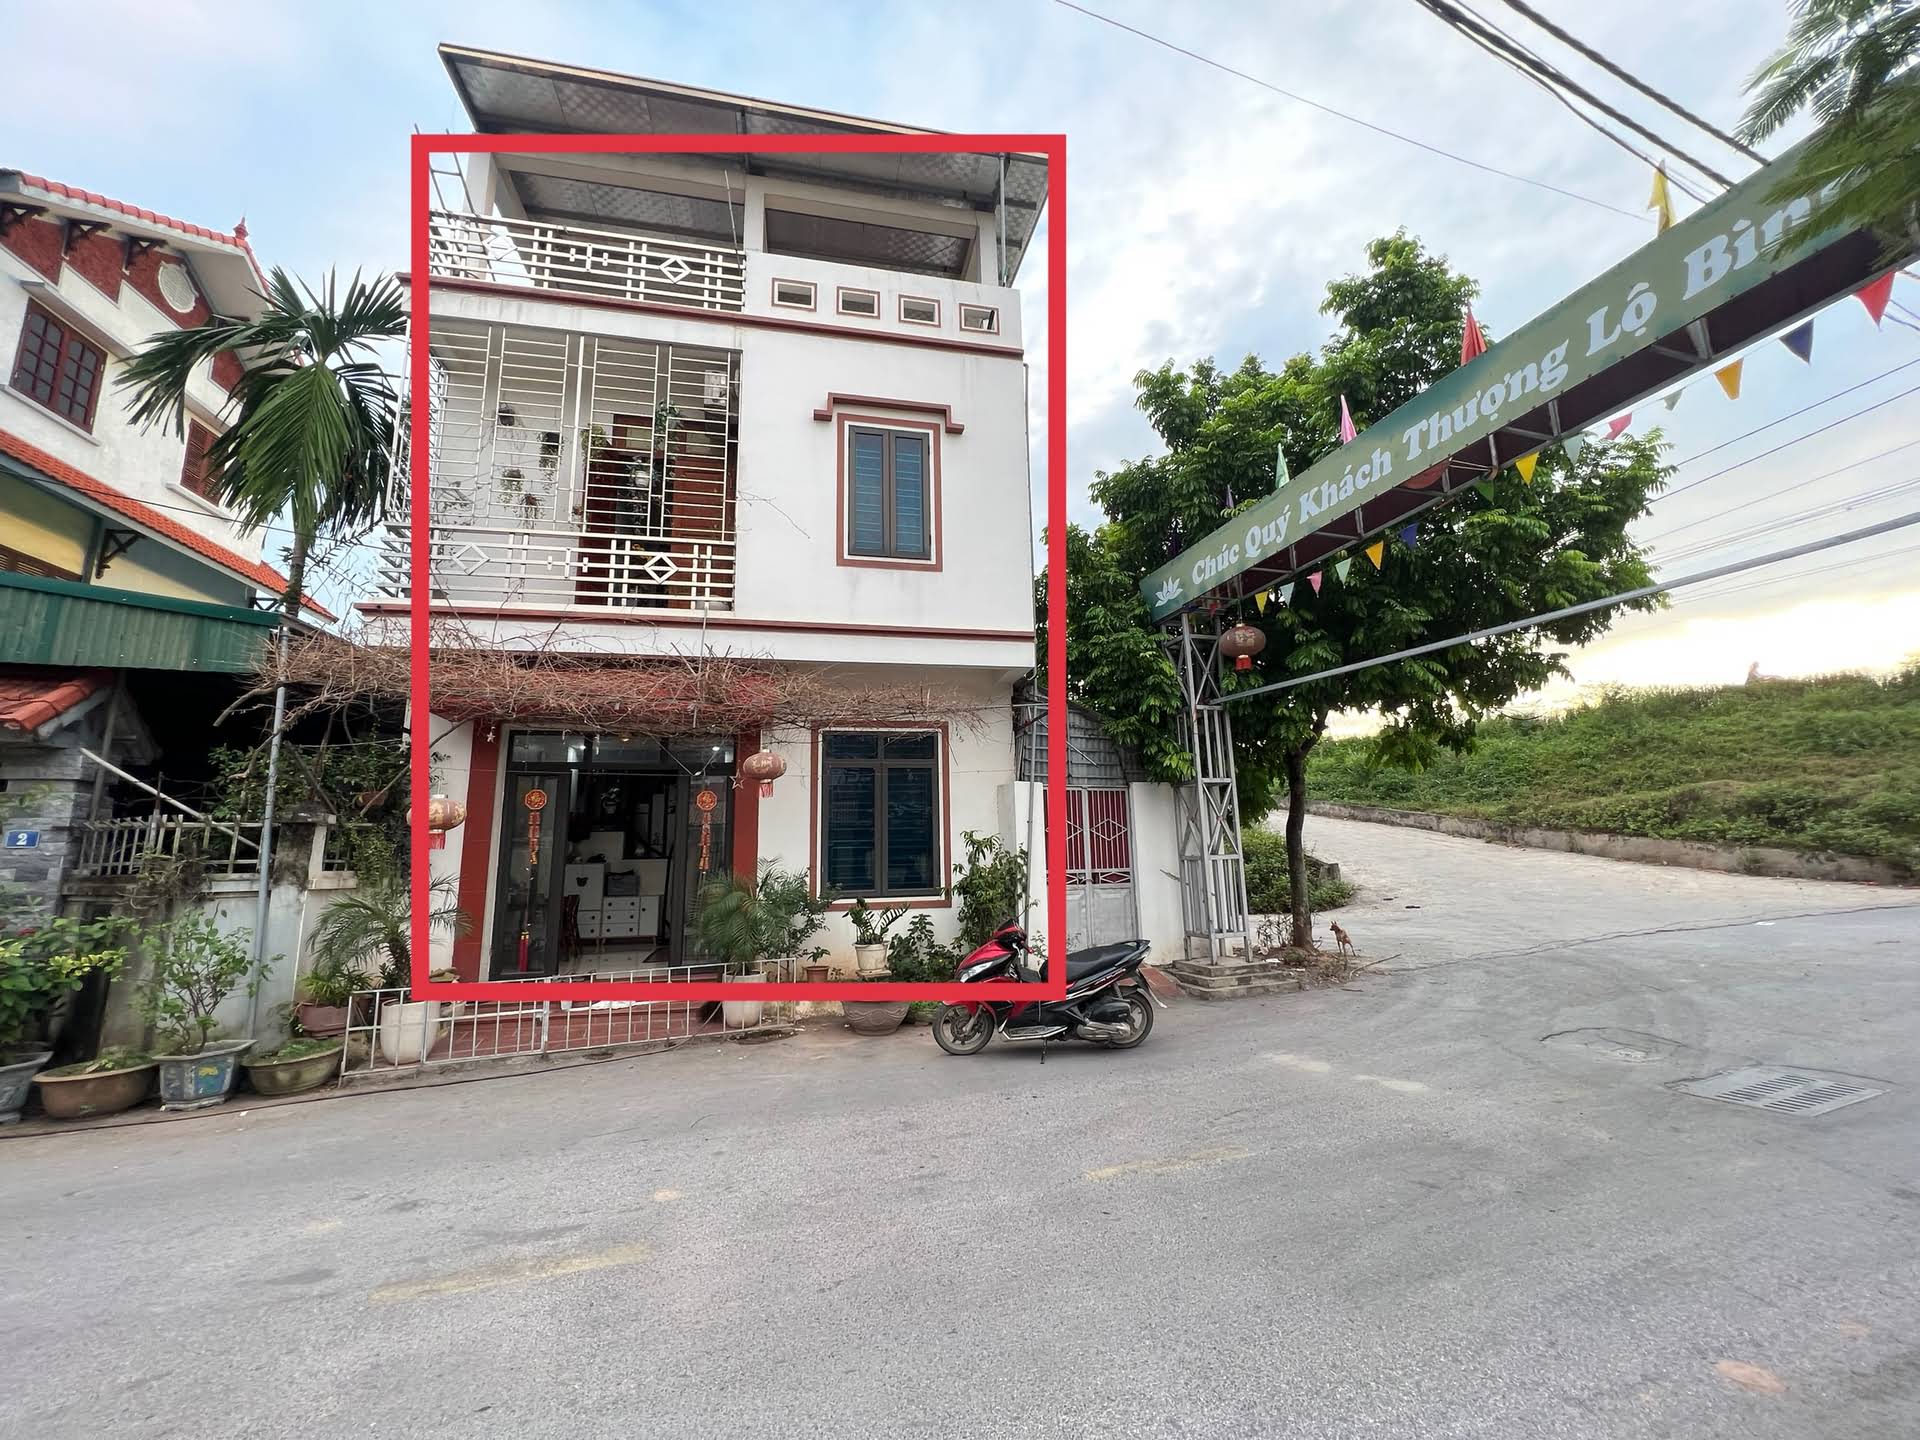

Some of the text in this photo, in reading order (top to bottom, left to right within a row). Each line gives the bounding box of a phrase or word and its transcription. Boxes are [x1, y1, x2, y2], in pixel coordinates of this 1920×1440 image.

[1191, 543, 1240, 586] Chúc
[1244, 504, 1291, 558] Quý
[1298, 447, 1393, 525] Khách
[1402, 338, 1569, 462] Thượng
[1585, 281, 1658, 357] Lộ
[16, 832, 28, 846] 2
